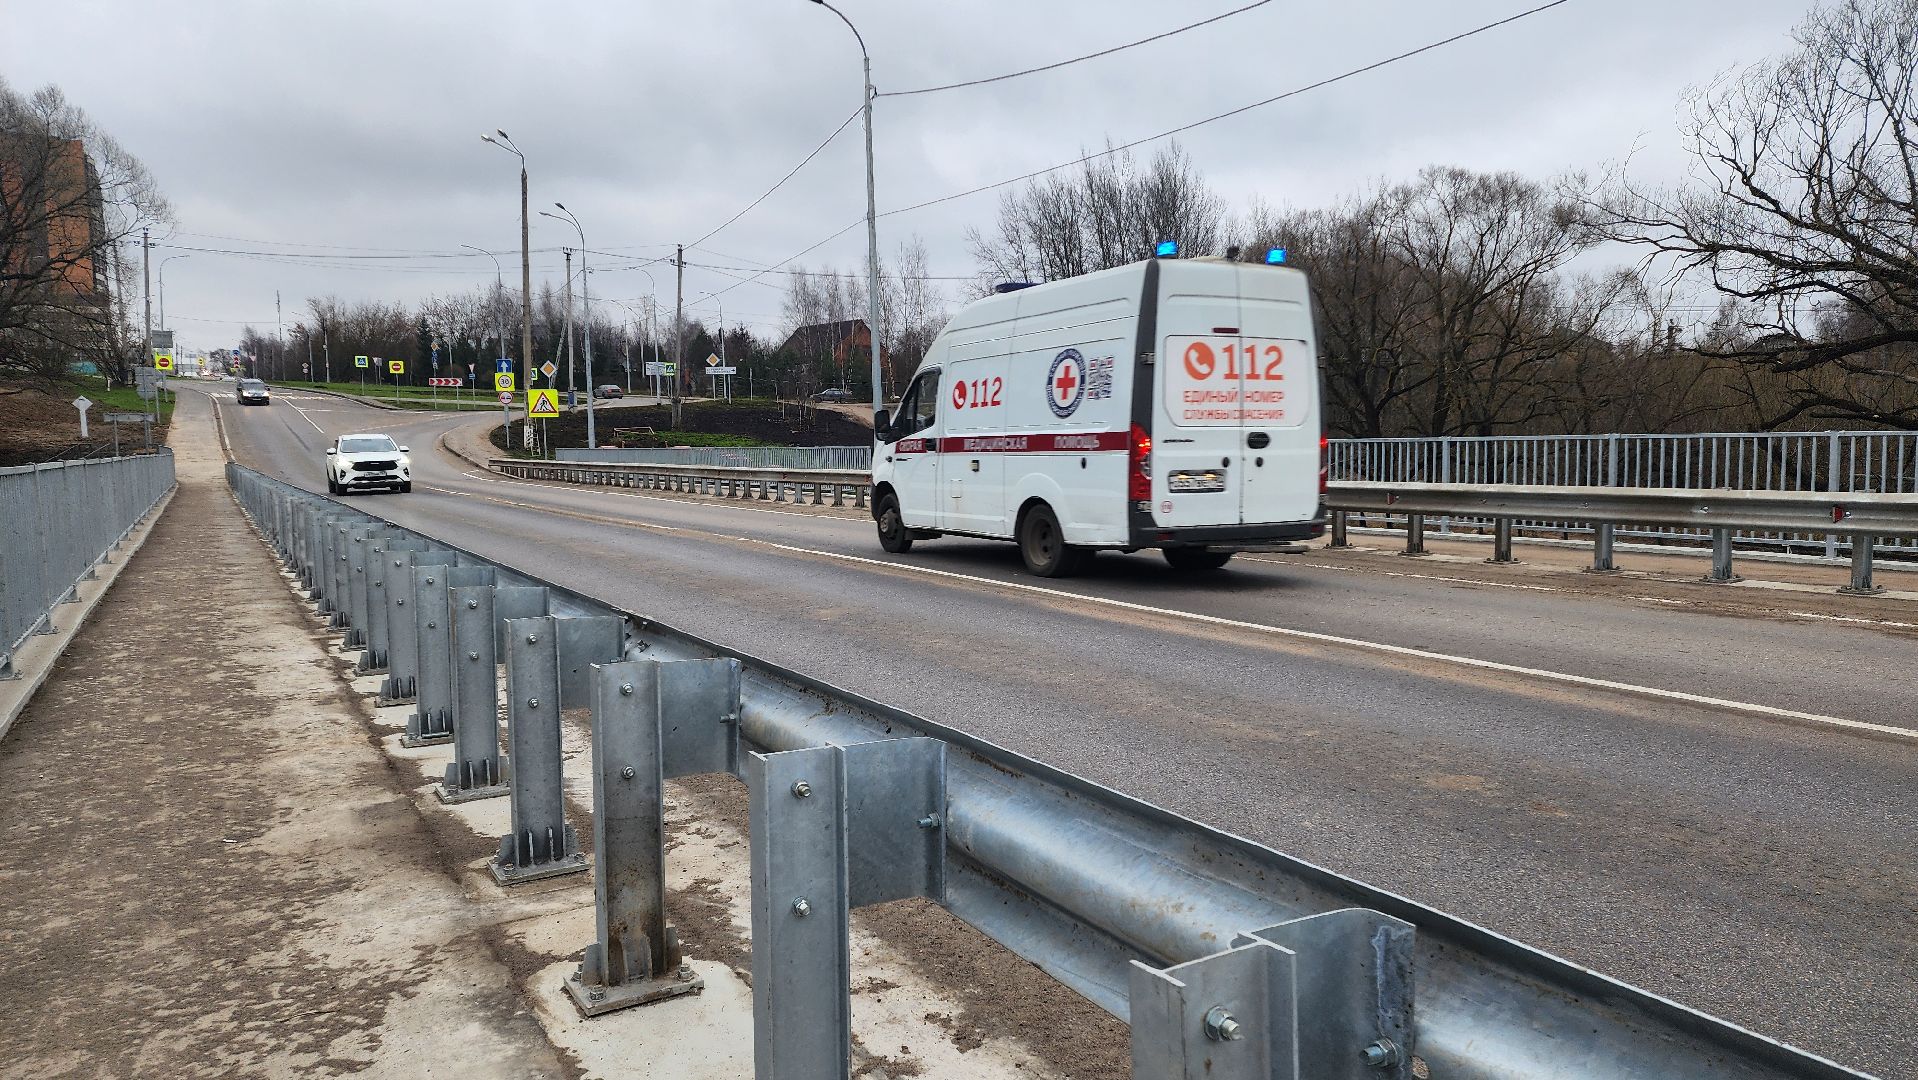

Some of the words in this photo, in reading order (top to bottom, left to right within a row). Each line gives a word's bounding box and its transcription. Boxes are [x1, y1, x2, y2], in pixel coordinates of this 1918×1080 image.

[1222, 344, 1284, 380] 112
[970, 376, 1003, 408] 112
[1184, 387, 1239, 404] ЕДИНЫЙ
[1244, 391, 1284, 402] НОМЕР
[963, 436, 1028, 452] МЕДИЦИНСКАЯ
[1053, 435, 1099, 450] ПОМОЩЬ
